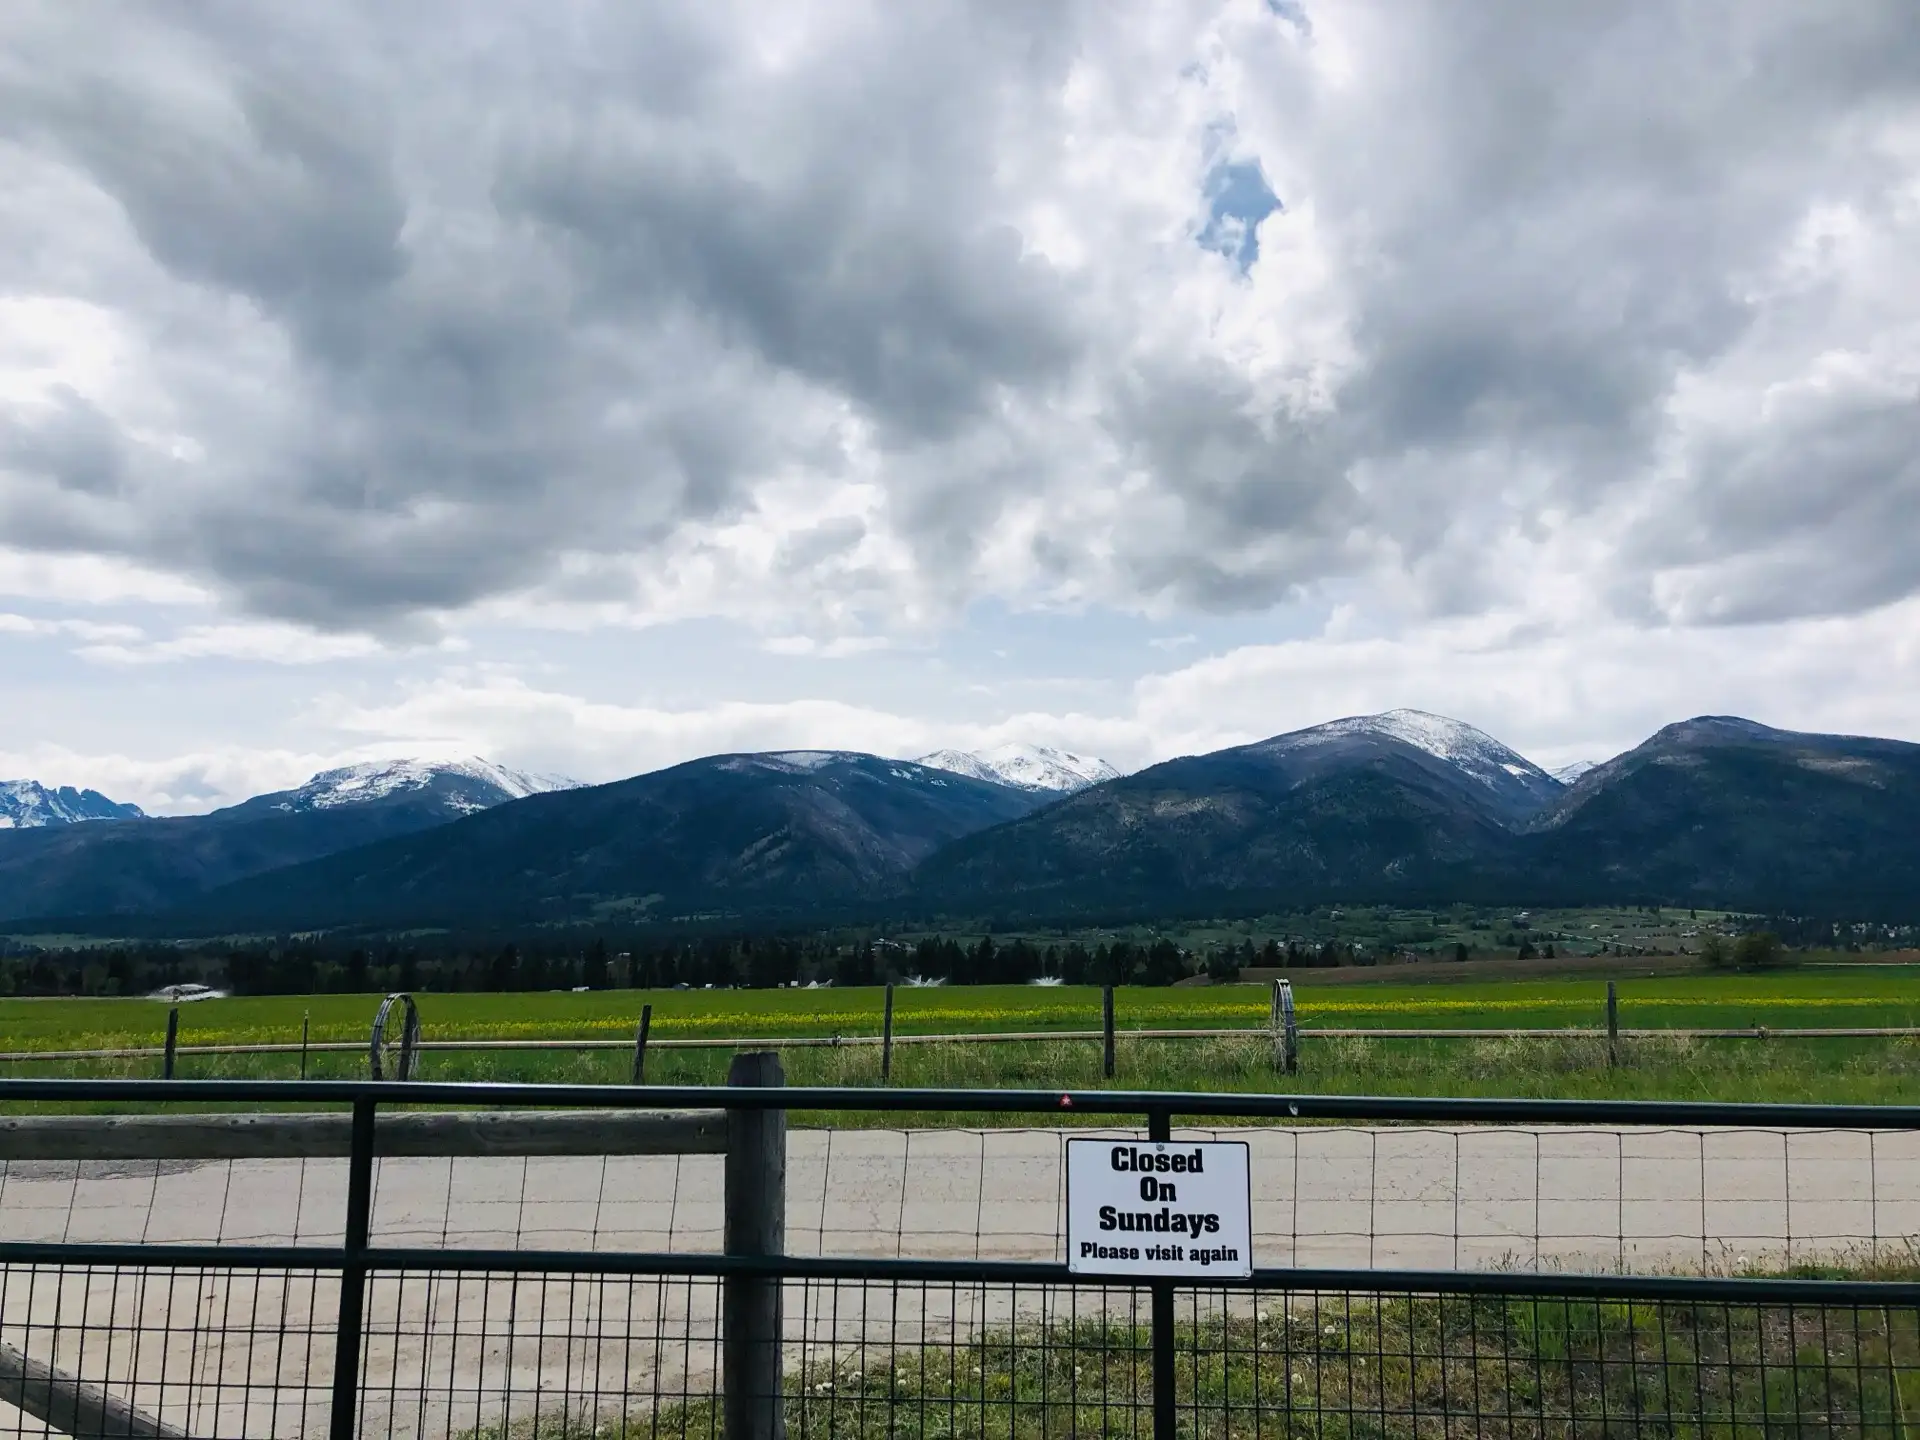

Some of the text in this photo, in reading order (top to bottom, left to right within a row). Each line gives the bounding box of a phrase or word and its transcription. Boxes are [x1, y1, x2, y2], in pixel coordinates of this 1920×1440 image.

[1111, 1147, 1204, 1173] Closed
[1140, 1176, 1177, 1202] On
[1099, 1206, 1220, 1239] Sundays
[1080, 1242, 1239, 1266] Please visit again
